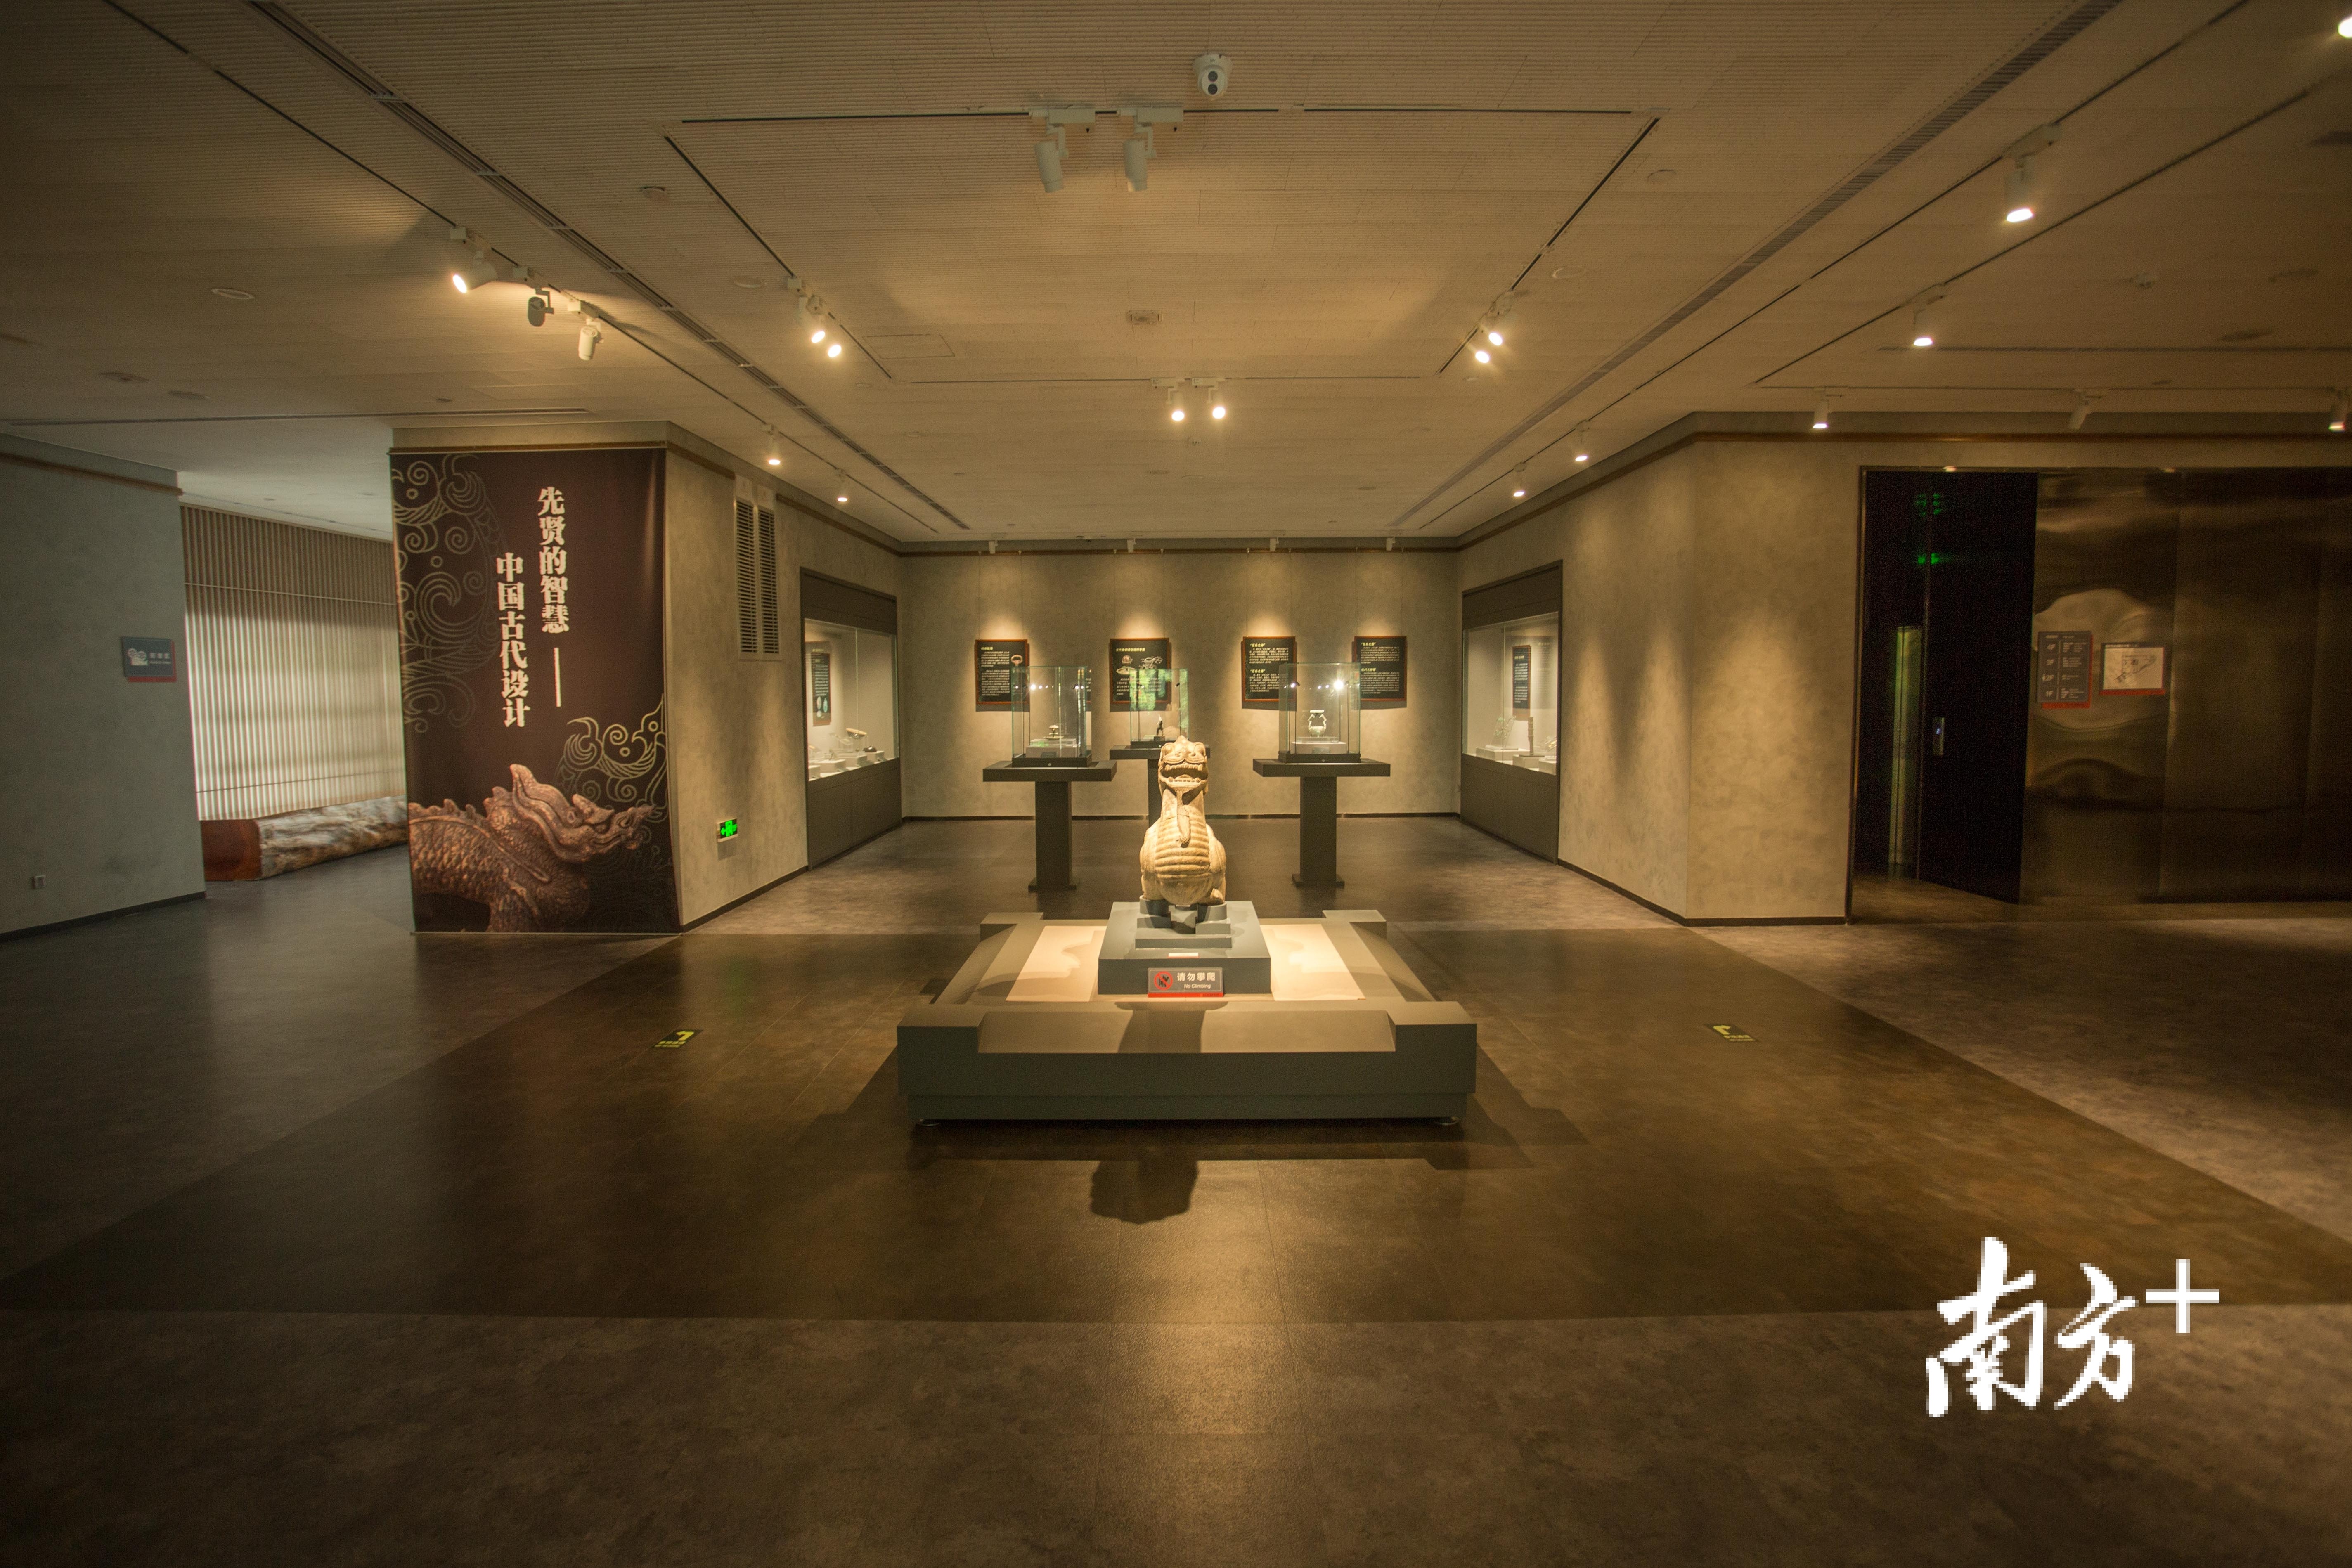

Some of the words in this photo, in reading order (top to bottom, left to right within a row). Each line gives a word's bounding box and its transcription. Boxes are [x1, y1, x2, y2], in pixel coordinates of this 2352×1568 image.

[497, 552, 530, 727] 中国古代设计
[1177, 972, 1216, 981] 请勿攀爬
